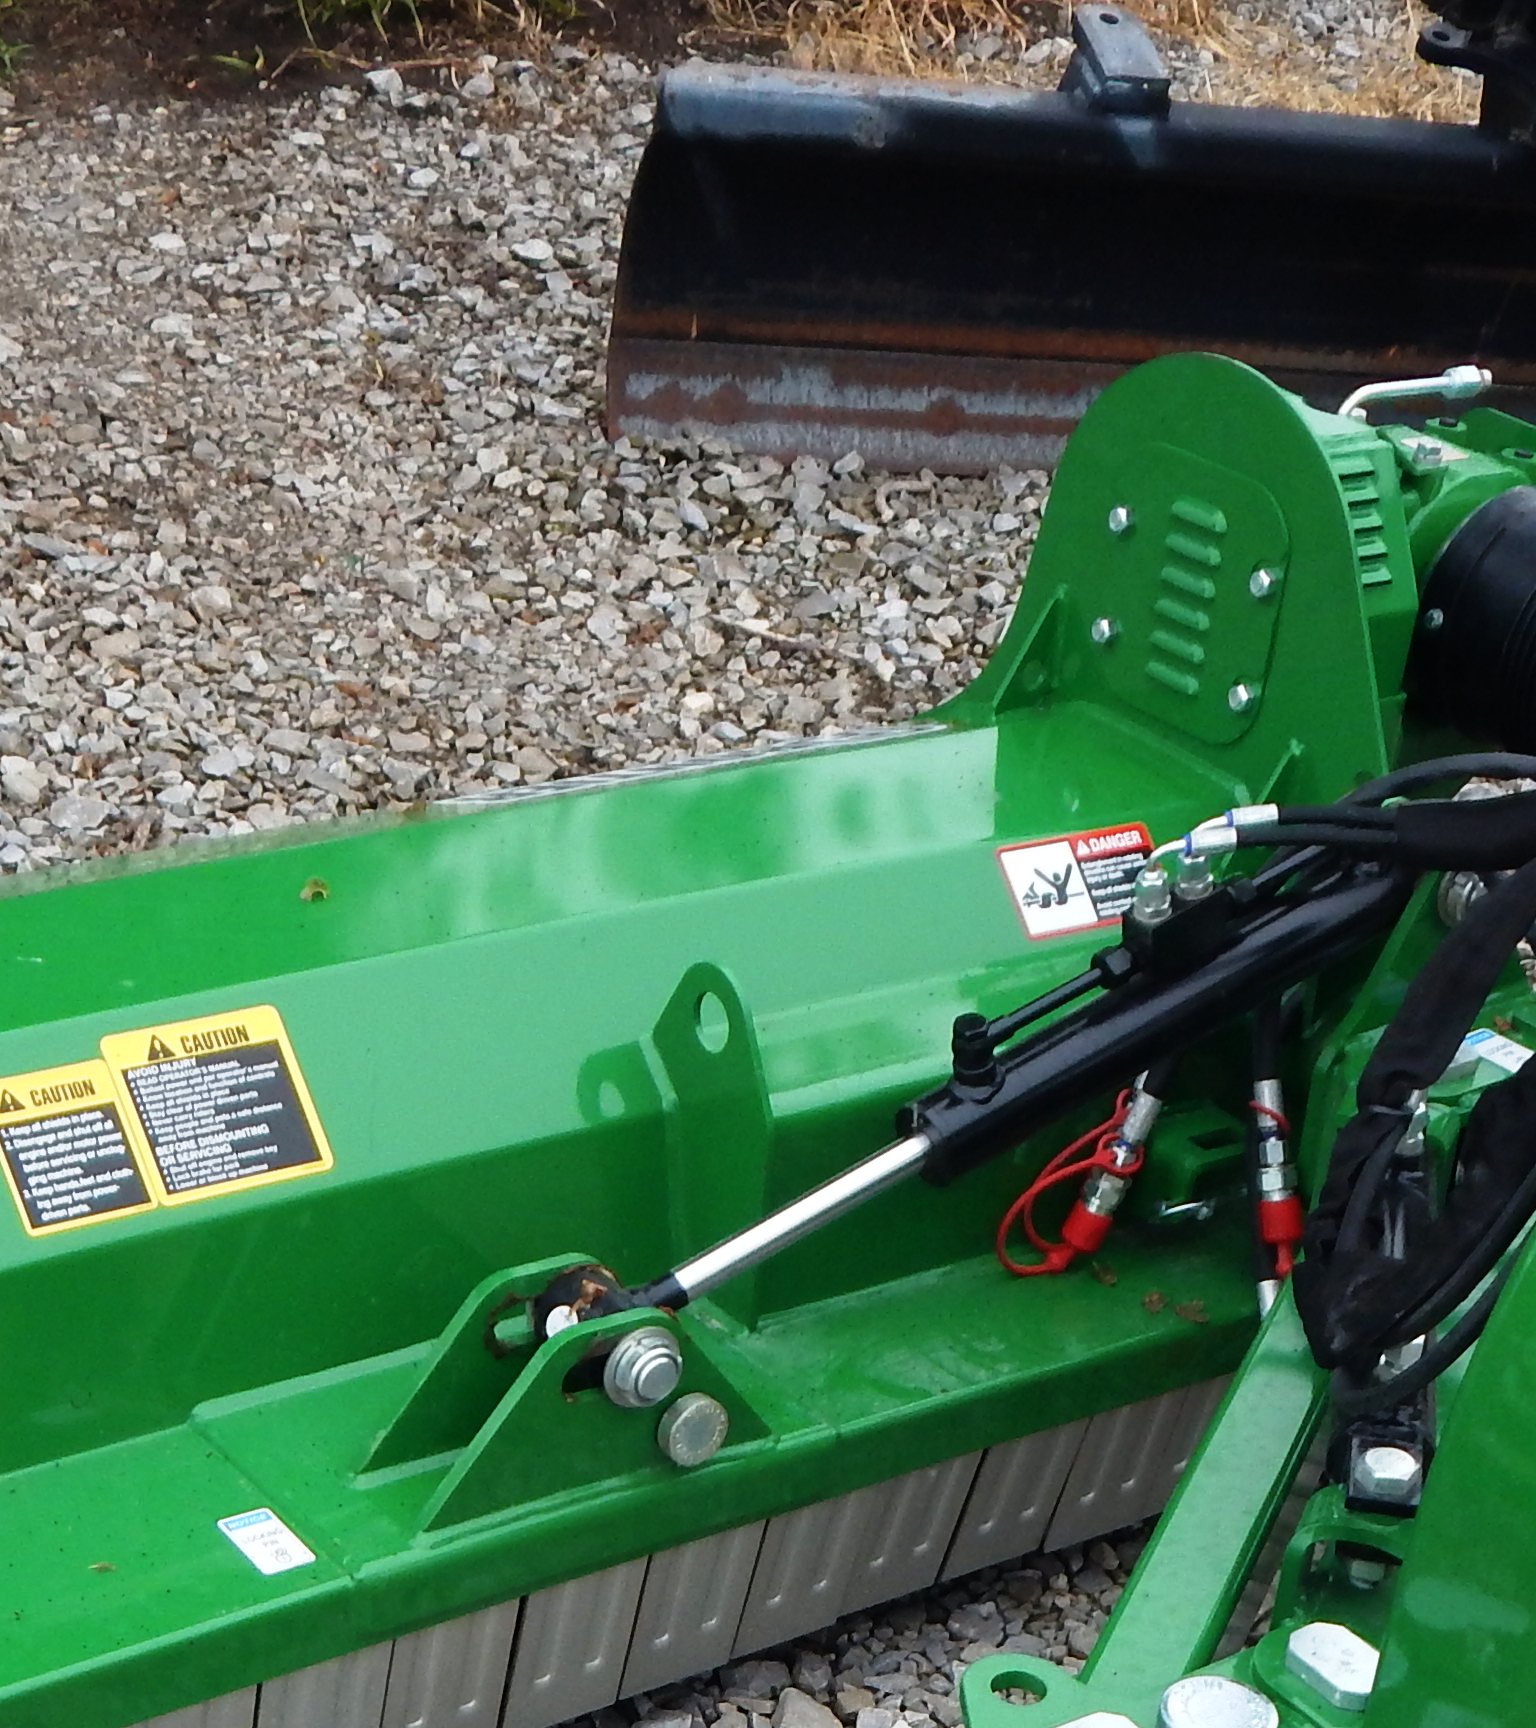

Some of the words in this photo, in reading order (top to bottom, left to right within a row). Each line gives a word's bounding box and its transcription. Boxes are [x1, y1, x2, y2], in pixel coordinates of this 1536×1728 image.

[1089, 830, 1142, 852] DANGER
[180, 1024, 250, 1054] CAUTION
[127, 1065, 159, 1078] AVOID
[161, 1057, 197, 1071] INJURY
[30, 1079, 96, 1106] CAUTION
[156, 1140, 196, 1155] BEFORE
[198, 1124, 269, 1146] DISMOUNTING
[160, 1156, 176, 1166] OR
[178, 1143, 232, 1162] SERVICING
